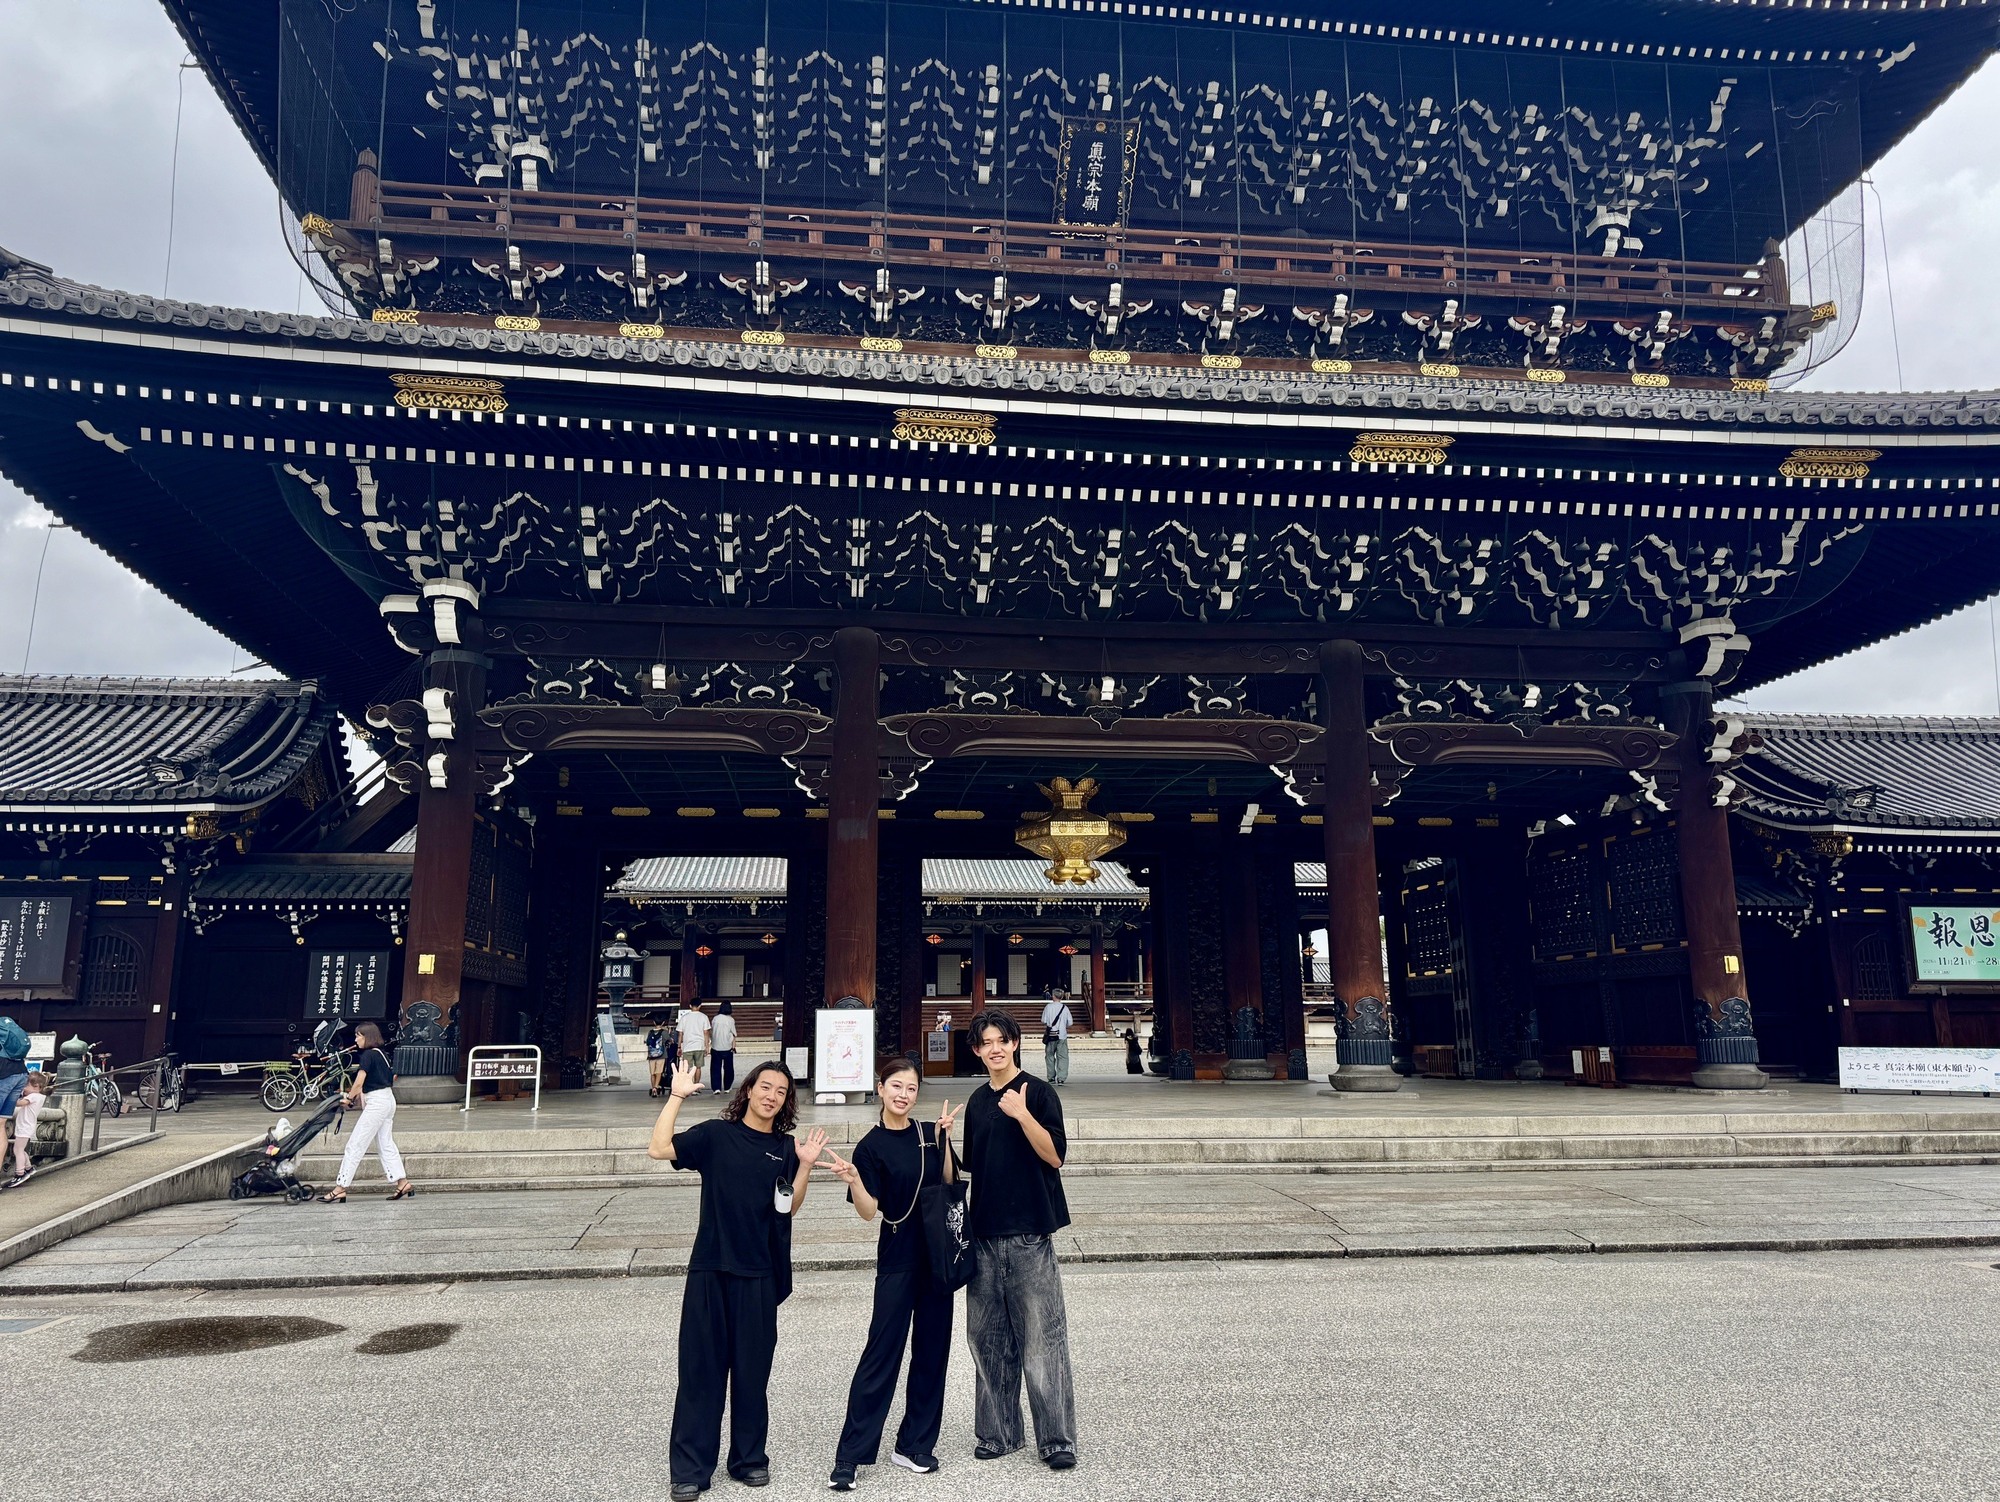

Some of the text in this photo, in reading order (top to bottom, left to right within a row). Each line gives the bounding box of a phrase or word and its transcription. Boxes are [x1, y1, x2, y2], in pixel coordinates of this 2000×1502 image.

[500, 1064, 534, 1074] 進入禁止
[1847, 1062, 1881, 1072] ようこそ
